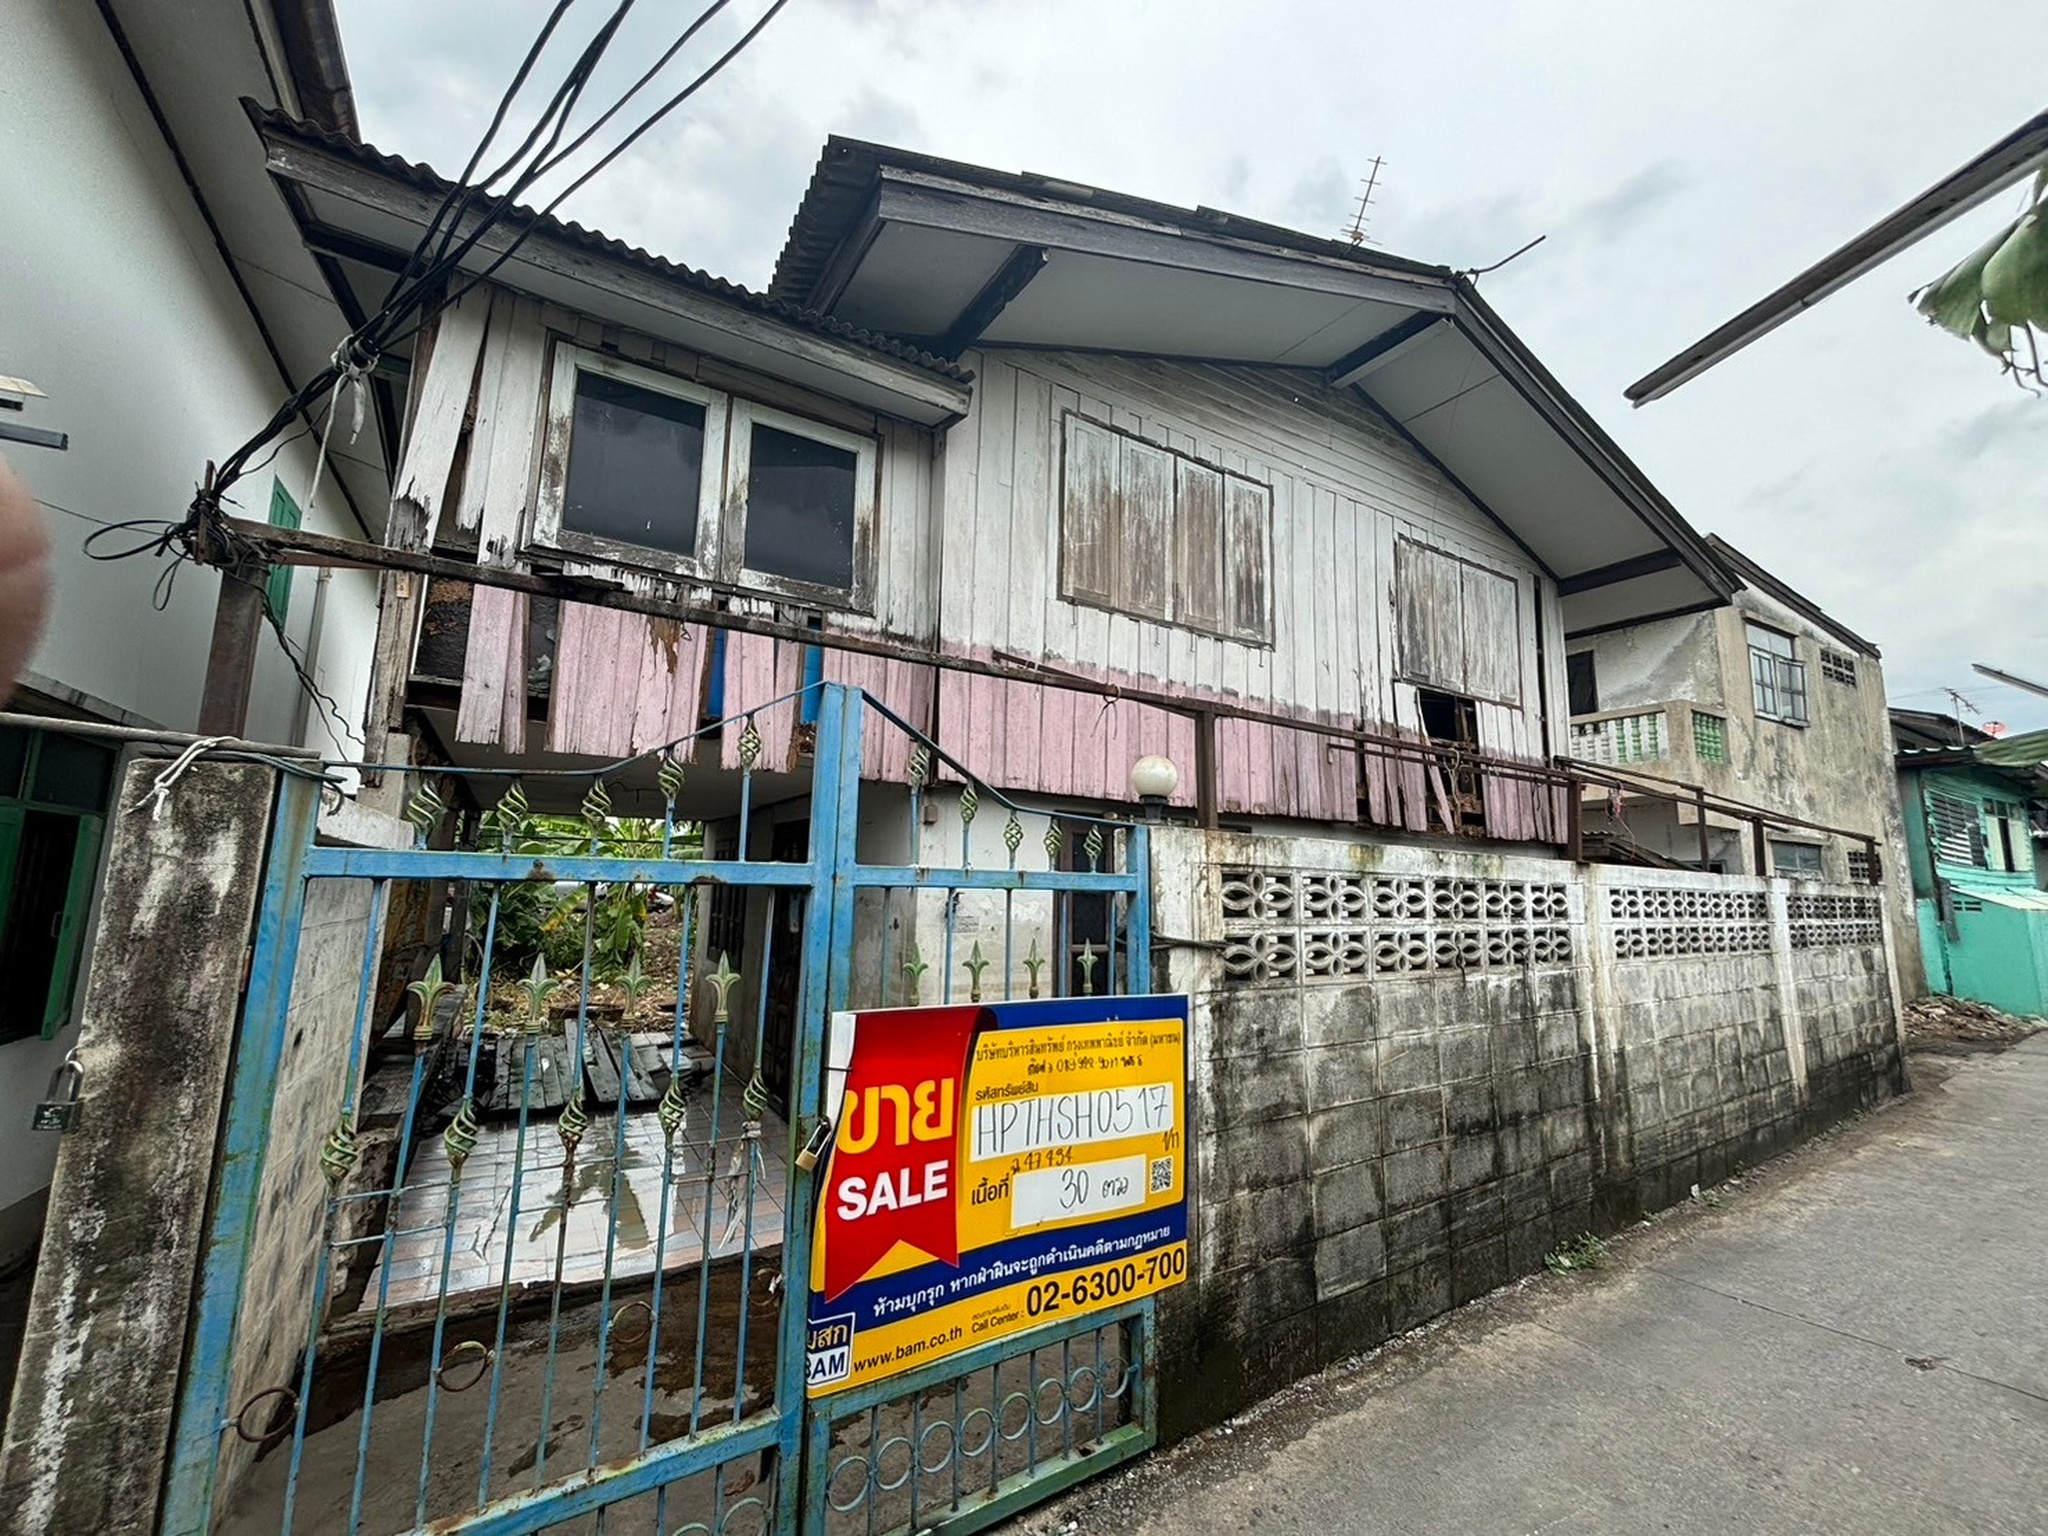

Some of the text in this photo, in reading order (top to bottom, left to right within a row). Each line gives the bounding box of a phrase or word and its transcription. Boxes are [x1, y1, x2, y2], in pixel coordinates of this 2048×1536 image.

[975, 1081, 1038, 1102] รหัสทรัพย์สิน
[837, 1078, 954, 1154] ขาย
[837, 1160, 949, 1221] SALE
[971, 1171, 1009, 1205] เนื้อที่
[1059, 1169, 1089, 1209] 30
[873, 1284, 944, 1317] ห้ามบุกรุก
[1026, 1247, 1185, 1317] 02-6300-700
[972, 1318, 989, 1333] Call
[854, 1326, 962, 1372] www.bam.co.th
